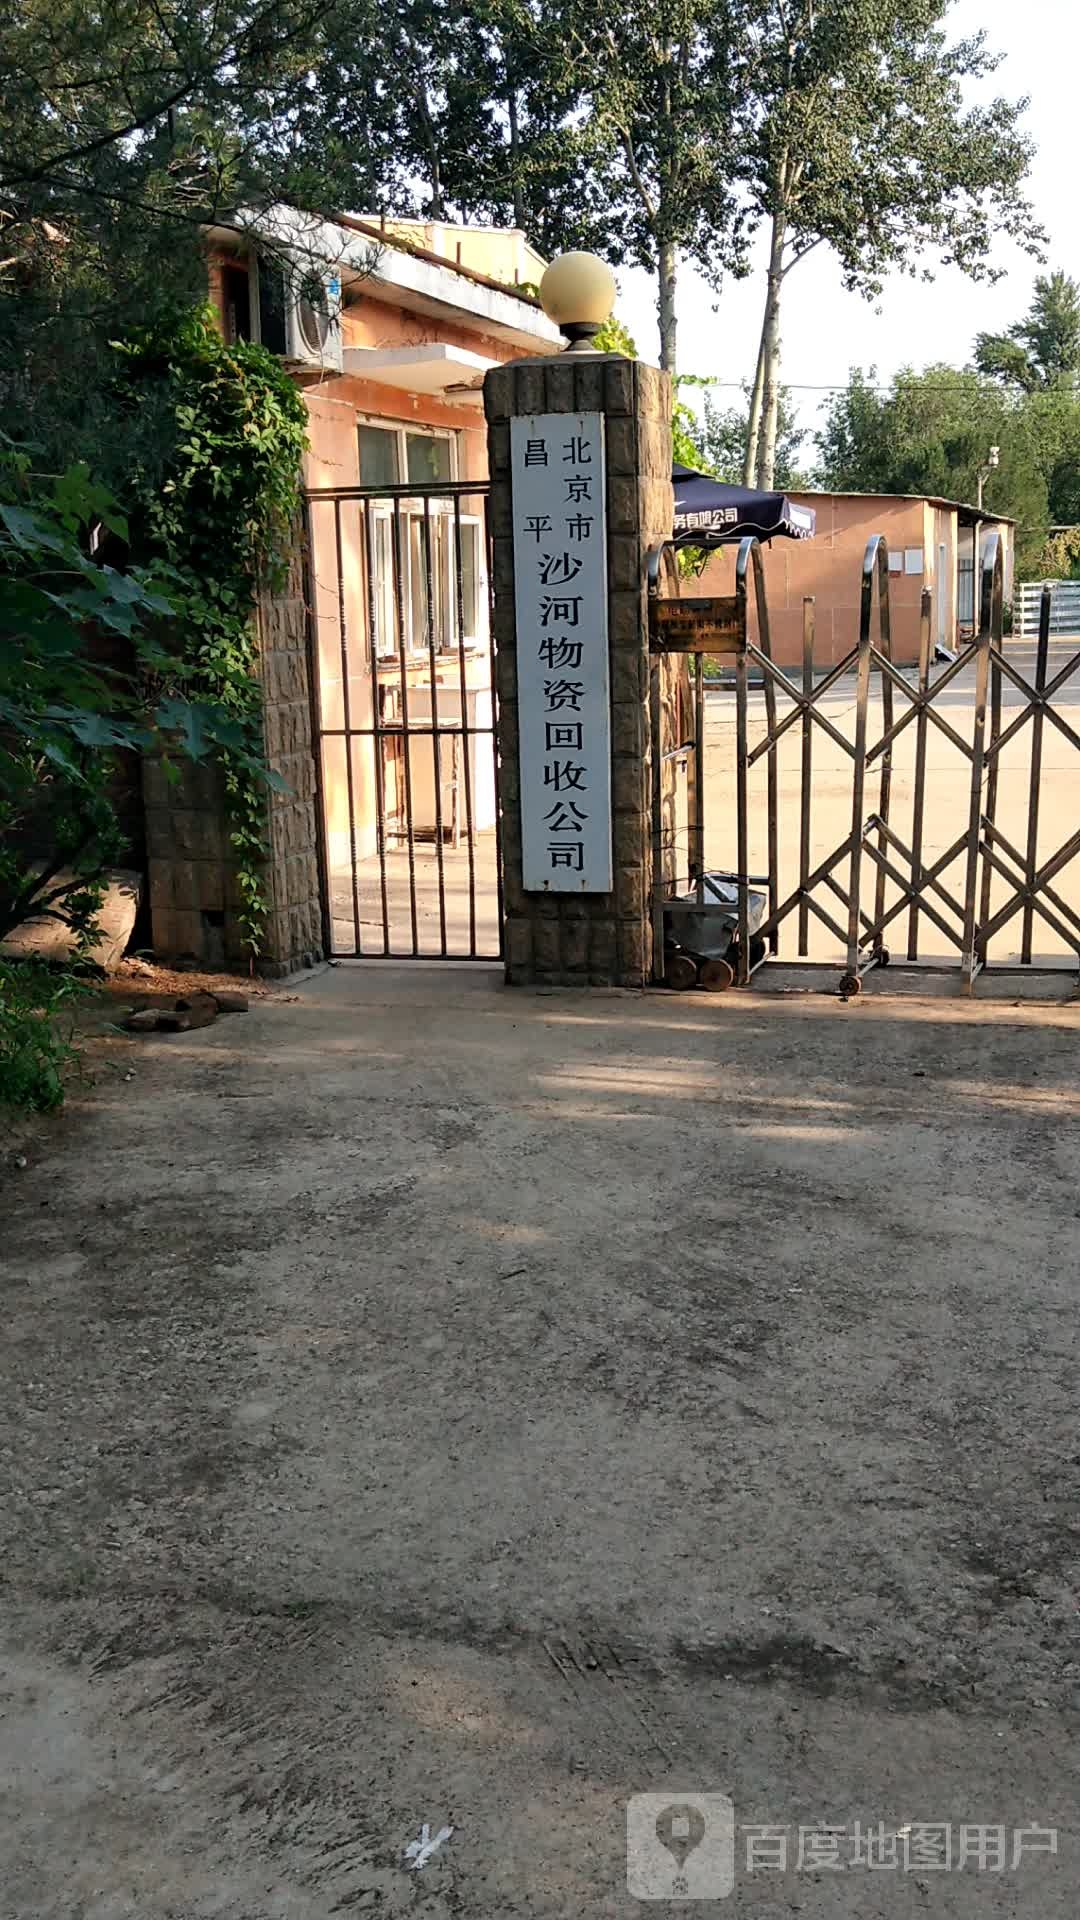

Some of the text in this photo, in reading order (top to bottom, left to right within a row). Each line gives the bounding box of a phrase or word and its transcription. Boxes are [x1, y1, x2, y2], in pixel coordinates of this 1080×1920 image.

[523, 438, 553, 544] 昌平
[562, 436, 594, 542] 北京市
[673, 507, 738, 530] 务有限公司
[537, 552, 589, 872] 沙河物资回收公司
